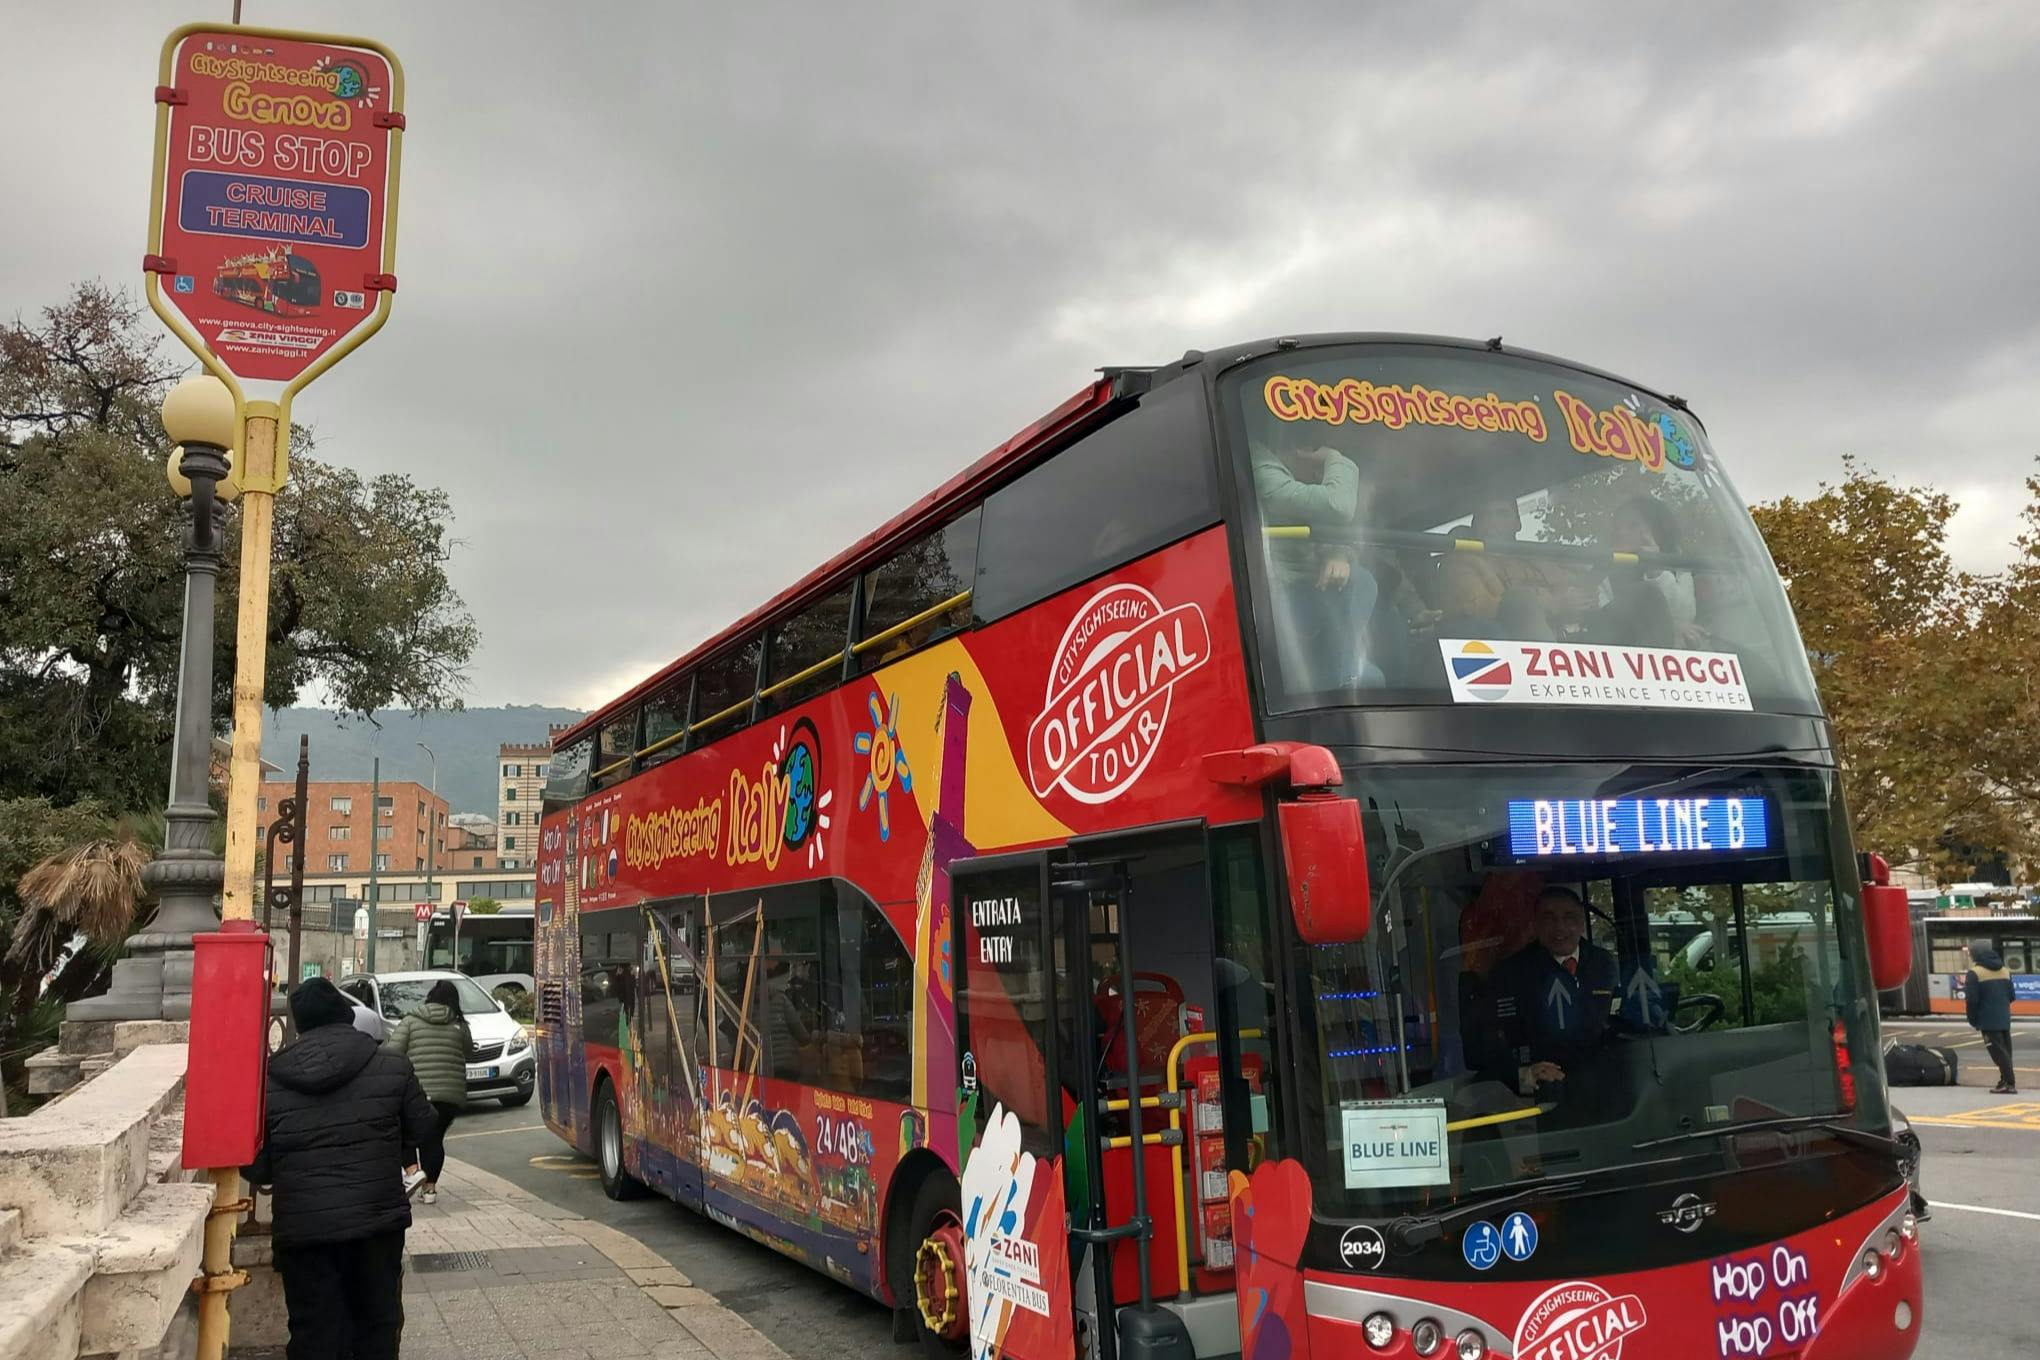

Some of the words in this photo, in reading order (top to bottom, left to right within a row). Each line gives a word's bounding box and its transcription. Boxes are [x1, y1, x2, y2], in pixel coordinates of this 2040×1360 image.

[190, 53, 340, 93] CitySightseeing
[223, 81, 352, 131] Genova
[188, 125, 265, 168] BUS
[273, 134, 372, 178] STOP
[226, 182, 327, 212] CRUISE
[206, 206, 344, 239] TERMINAL
[198, 317, 337, 338] www.genova.city-sightseeing.it
[225, 344, 309, 358] www.zaniviaggi.it
[1264, 376, 1548, 443] CitySightseeing
[1554, 391, 1665, 473] Italy
[1058, 599, 1149, 685] CITYSIGHTSEEING
[1520, 647, 1615, 679] ZANI
[1623, 652, 1741, 686] VIAGGI
[1043, 618, 1197, 771] OFFICIAL
[1530, 684, 1651, 701] EXPERIENCE
[1660, 688, 1747, 705] TOGETHER
[1089, 710, 1159, 785] TOUR
[625, 797, 722, 872] CitySightseeing
[727, 761, 791, 872] Italy
[1533, 800, 1620, 855] BLUE
[1636, 799, 1712, 852] LINE
[1727, 799, 1745, 850] B
[543, 828, 554, 854] Hop
[553, 824, 562, 850] On
[541, 863, 551, 887] Hop
[416, 905, 431, 917] M
[972, 897, 1022, 927] ENTRATA
[980, 936, 1013, 964] ENTRY
[816, 1115, 858, 1164] 24/48
[1352, 1143, 1395, 1159] BLUE
[1401, 1141, 1438, 1157] LINE
[1004, 1238, 1037, 1268] ZANI
[1343, 1241, 1382, 1255] 2034
[1712, 1262, 1765, 1300] Hop
[1772, 1246, 1807, 1287] On
[989, 1274, 1031, 1305] FLORENTIA
[1032, 1291, 1047, 1312] BUS
[1524, 1290, 1600, 1341] CITYSIGHTSEEING
[1719, 1317, 1772, 1356] Hop
[1779, 1296, 1817, 1342] Off
